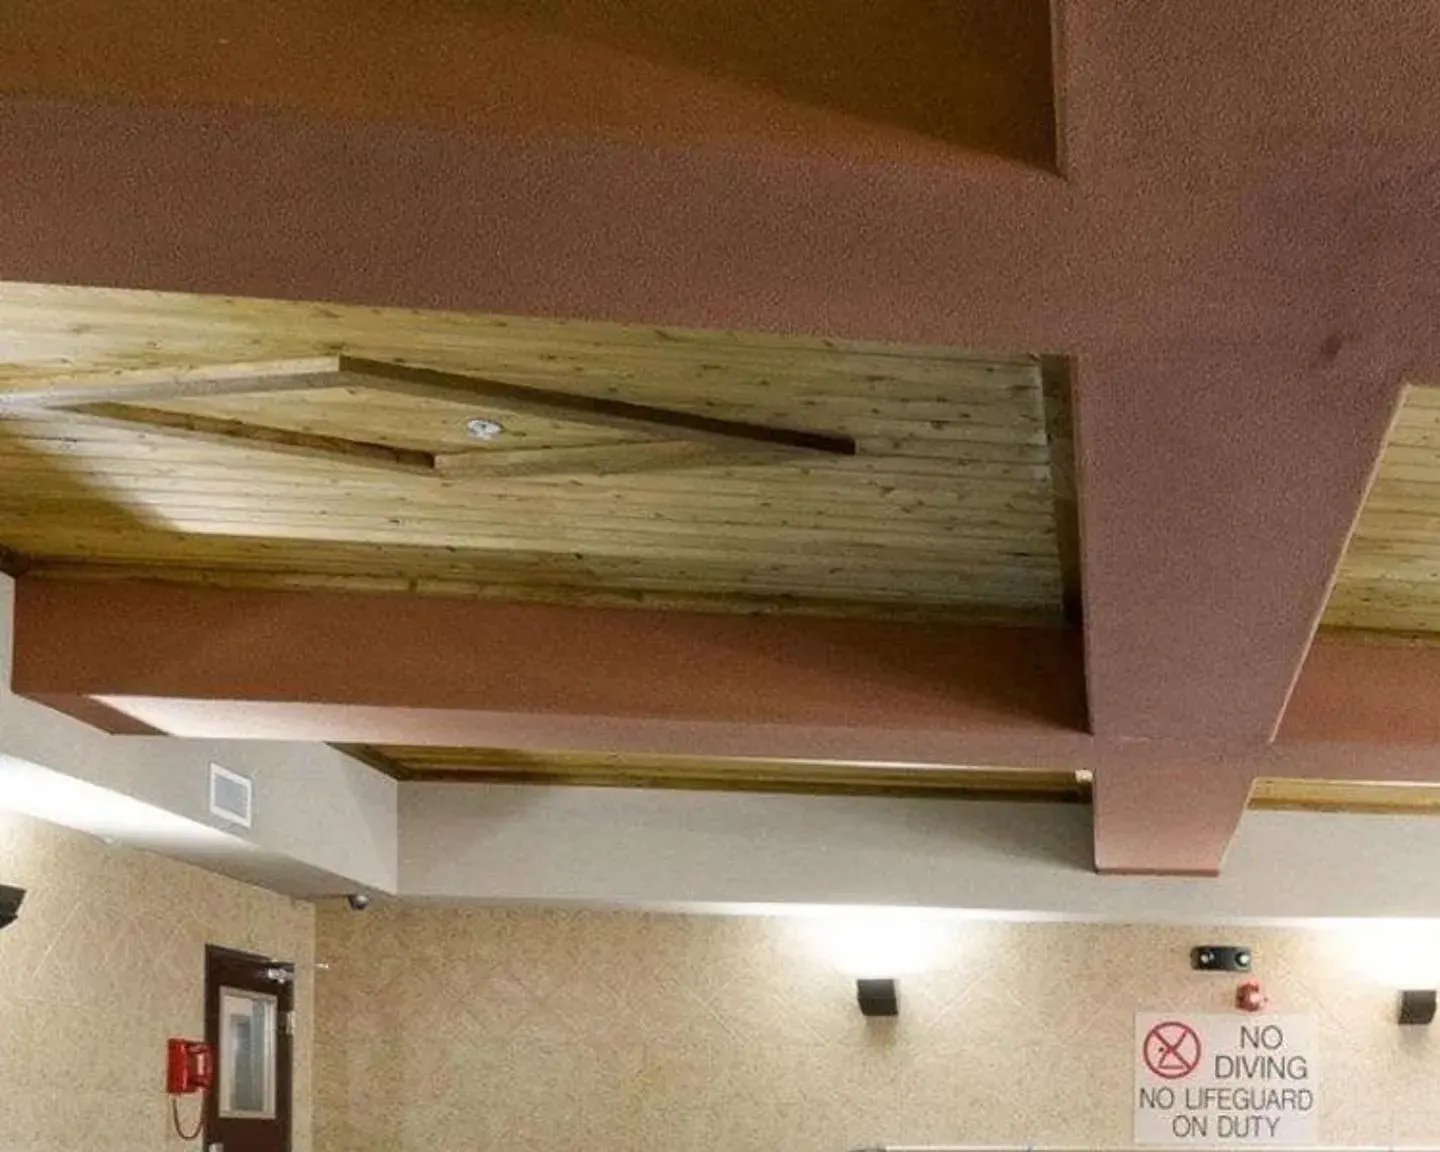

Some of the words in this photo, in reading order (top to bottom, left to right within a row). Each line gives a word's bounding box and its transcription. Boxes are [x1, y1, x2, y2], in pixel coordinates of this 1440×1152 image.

[1240, 1024, 1284, 1050] NO
[1214, 1055, 1308, 1080] DIVING
[1139, 1086, 1175, 1110] NO
[1185, 1087, 1314, 1112] LIFEGUARD
[1172, 1115, 1208, 1138] ON
[1217, 1115, 1281, 1138] DUTY
